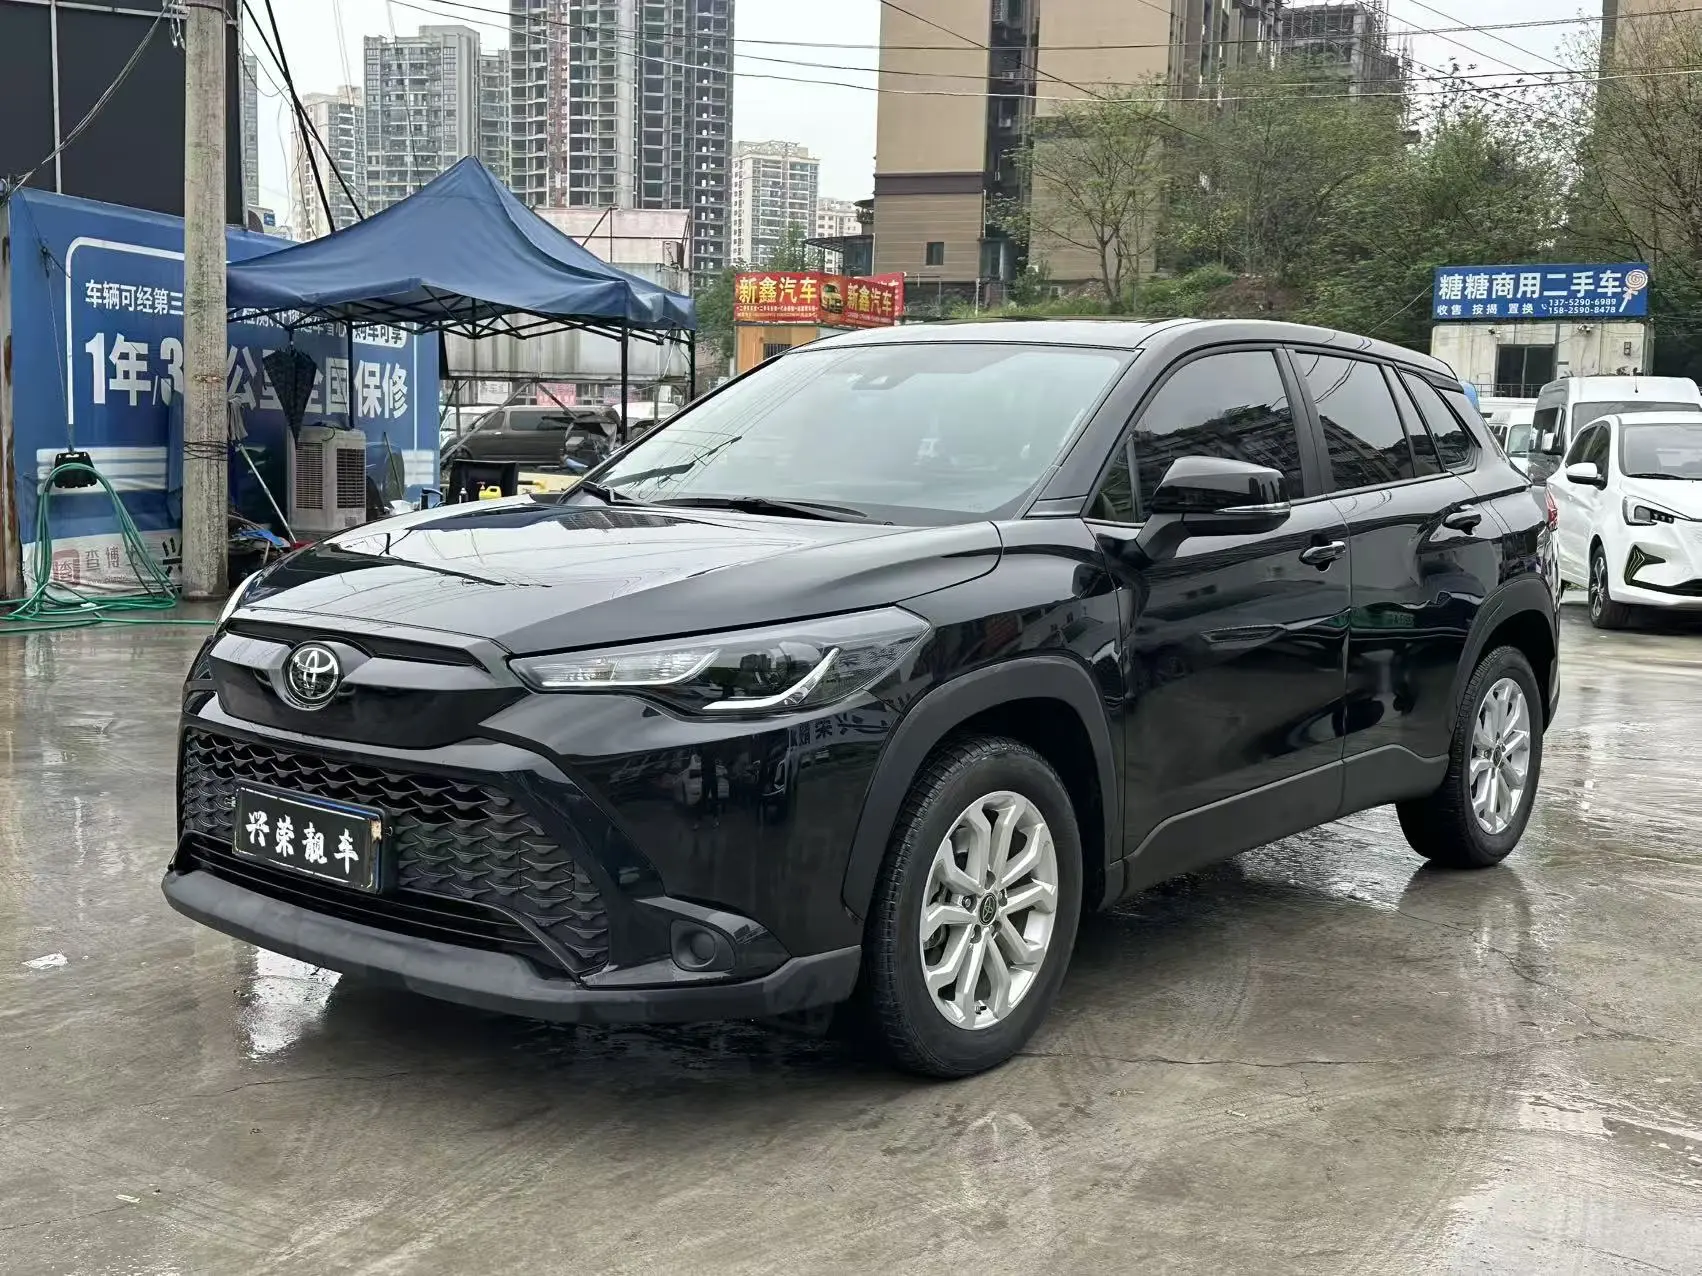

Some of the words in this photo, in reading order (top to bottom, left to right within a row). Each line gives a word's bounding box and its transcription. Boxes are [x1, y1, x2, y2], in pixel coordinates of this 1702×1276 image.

[85, 279, 184, 315] 车辆可经第三
[739, 277, 817, 304] 新鑫汽车
[1439, 270, 1622, 299] 糖糖商用二手车
[848, 282, 892, 316] 新鑫汽车
[1437, 304, 1462, 316] 收售
[1472, 303, 1498, 315] 按揭
[1508, 302, 1534, 314] 置换
[1549, 298, 1617, 306] 137-5290-6989
[1549, 306, 1616, 314] 158-2590-8478
[246, 811, 359, 874] 兴荣靓车
